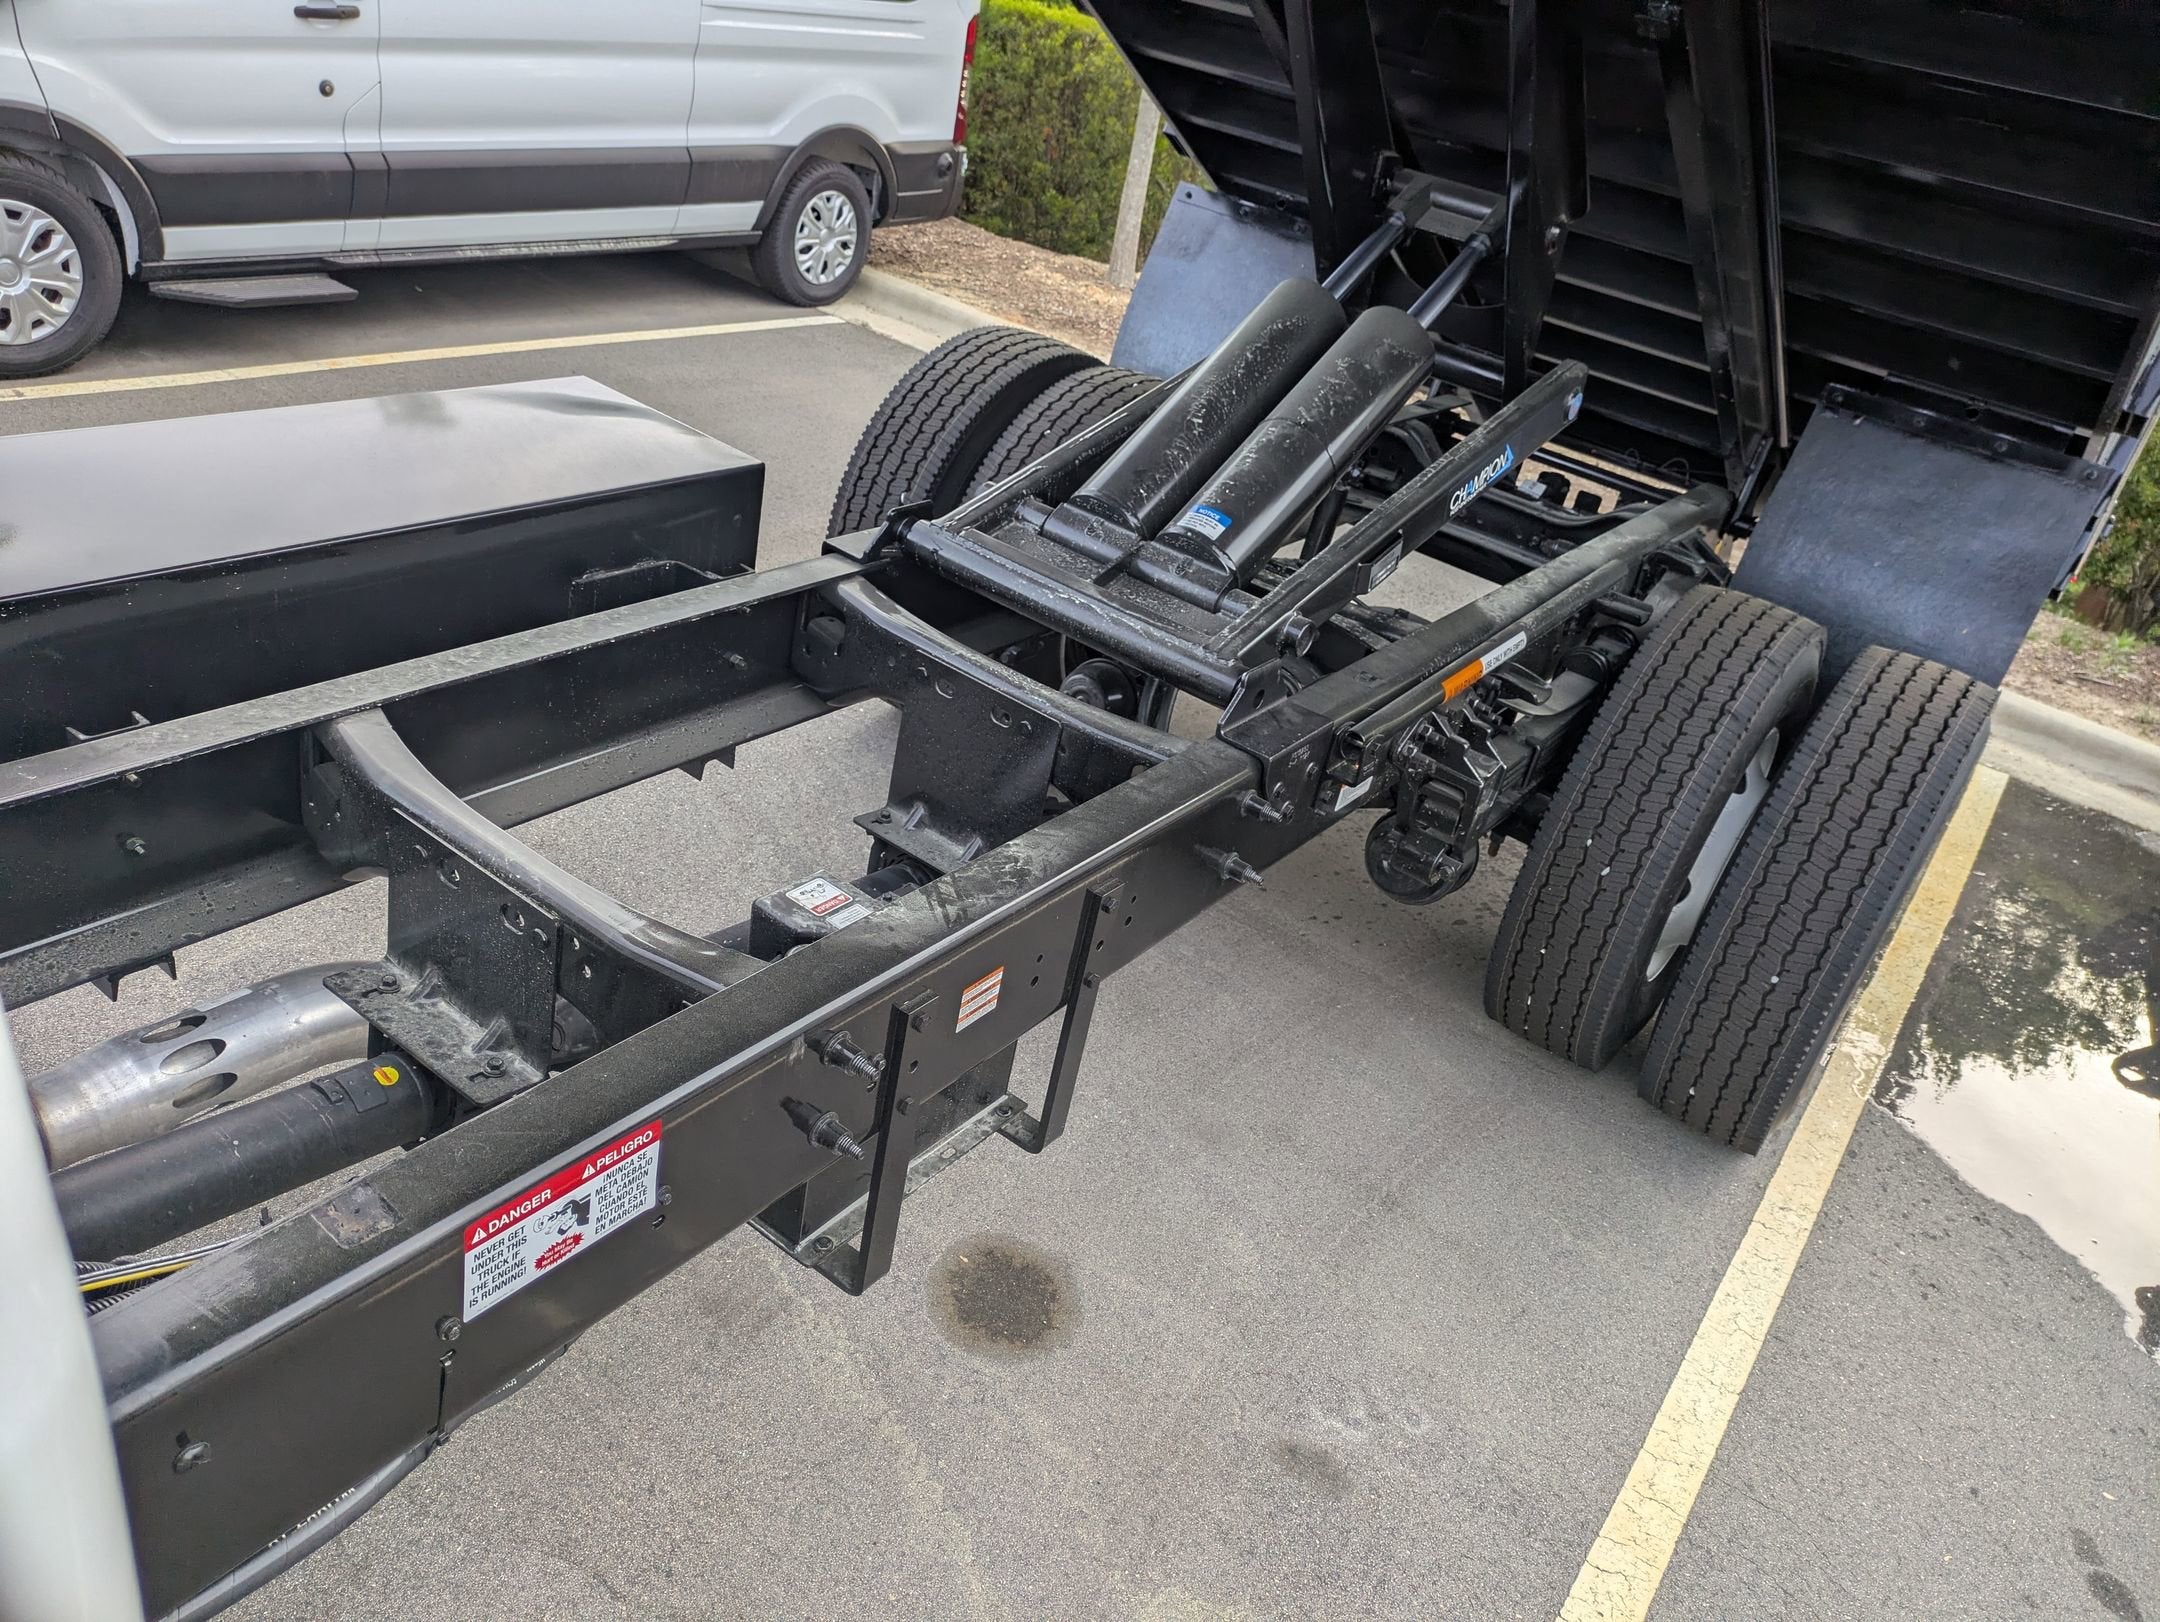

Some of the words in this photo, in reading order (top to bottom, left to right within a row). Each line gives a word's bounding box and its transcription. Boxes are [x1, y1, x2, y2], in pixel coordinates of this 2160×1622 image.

[1450, 450, 1508, 510] CHAMPION
[1198, 508, 1221, 520] NOTICE
[596, 1130, 653, 1171] PELIGRO
[603, 1159, 634, 1183] ¡NUNCA
[637, 1151, 648, 1163] SE
[595, 1178, 618, 1197] META
[621, 1157, 653, 1182] DEBAJO
[489, 1189, 551, 1233] DANGER
[595, 1223, 606, 1235] EN
[608, 1197, 647, 1226] MARCHA!
[596, 1201, 626, 1225] MOTOR
[598, 1191, 613, 1205] DEL
[599, 1187, 633, 1213] CUANDO
[636, 1181, 645, 1191] EL
[471, 1249, 504, 1275] UNDER
[506, 1236, 527, 1253] THIS
[474, 1238, 505, 1262] NEVER
[508, 1225, 526, 1242] GET
[471, 1279, 489, 1296] THE
[492, 1256, 526, 1283] ENGINE
[477, 1256, 509, 1281] TRUCK
[512, 1249, 520, 1261] IF
[469, 1297, 479, 1308] IS
[481, 1267, 527, 1301] RUNNING!
